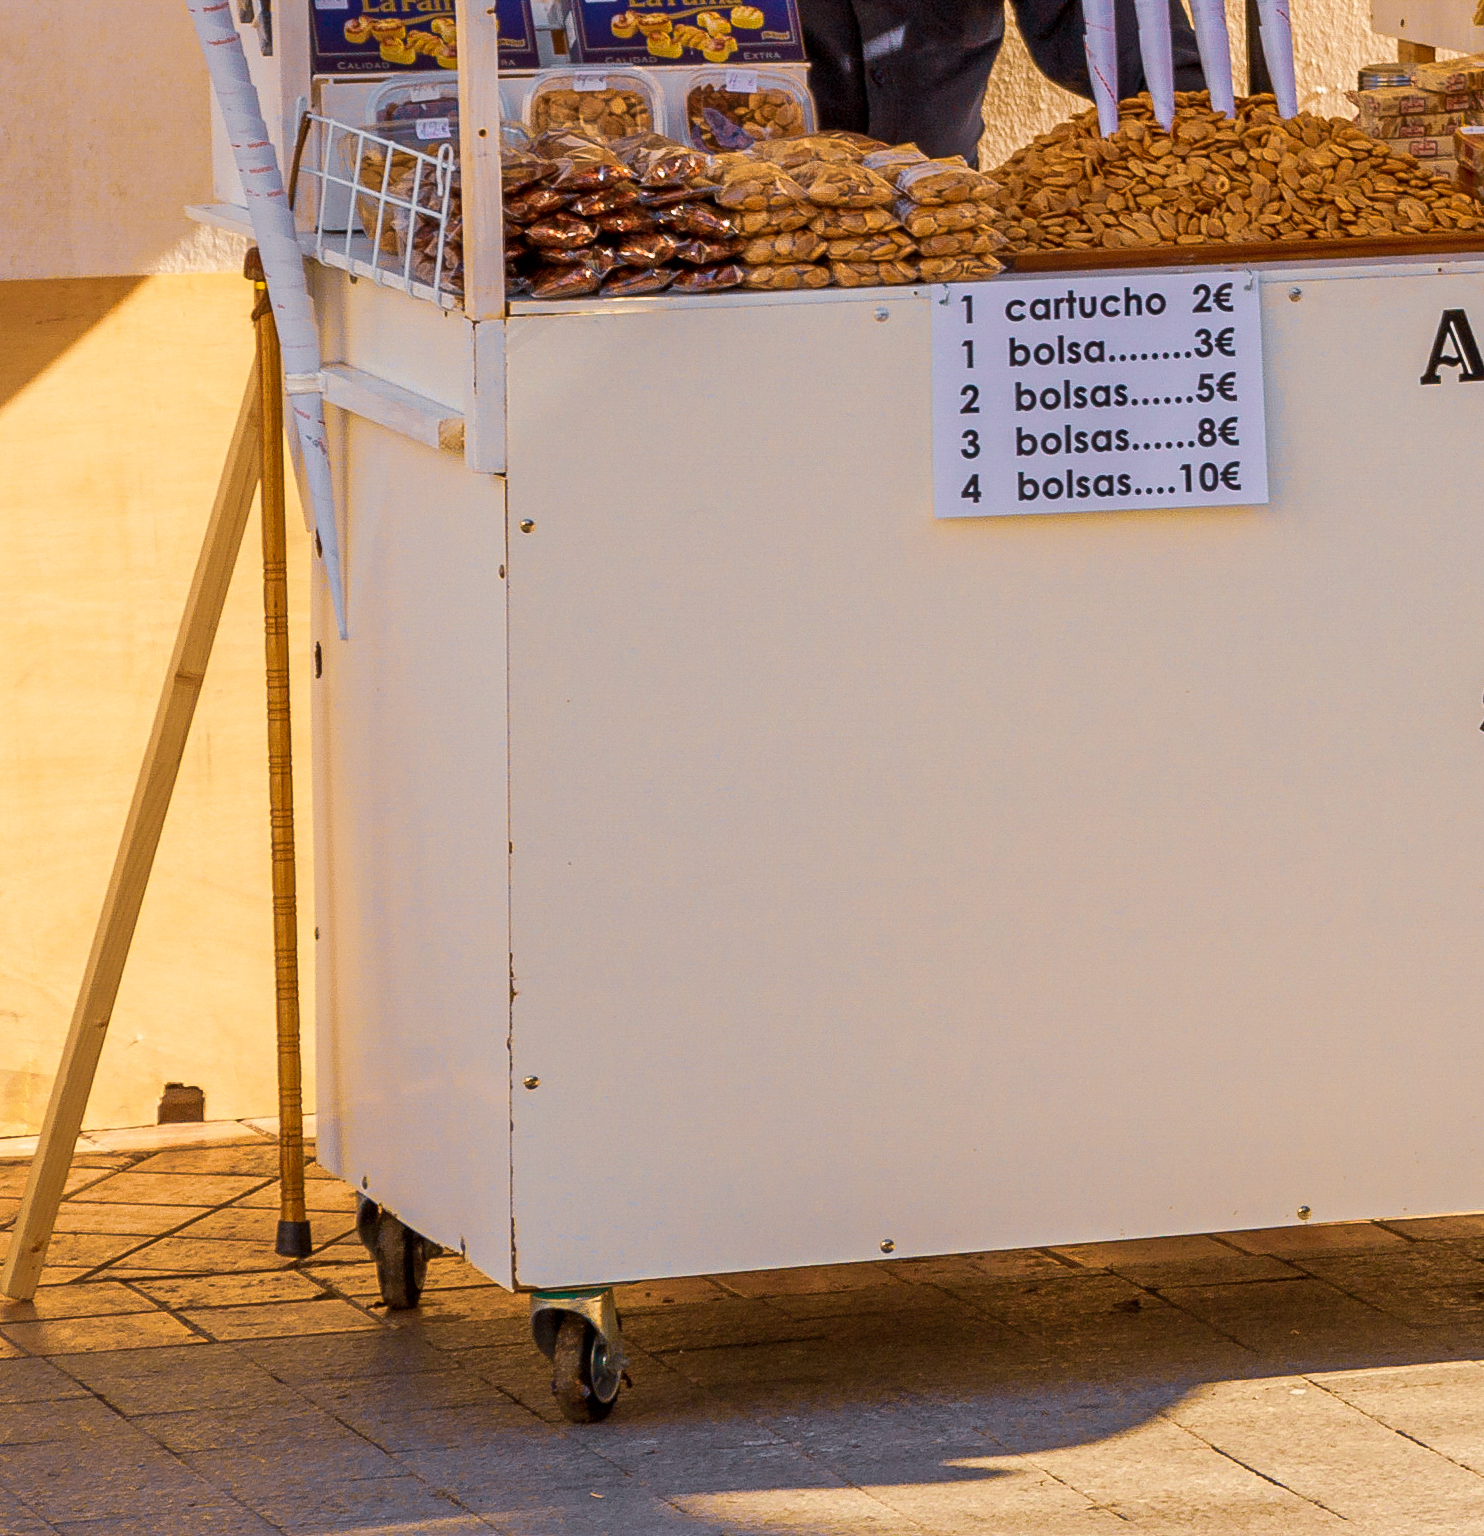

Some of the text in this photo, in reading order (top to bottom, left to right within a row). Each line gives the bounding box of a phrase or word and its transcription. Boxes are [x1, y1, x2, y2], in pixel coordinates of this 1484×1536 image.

[337, 61, 390, 70] CALIDAD
[743, 52, 782, 61] EXTRA
[961, 282, 1234, 324] 1 cartucho 2€
[961, 340, 974, 369] 1
[960, 385, 980, 414] 2
[961, 429, 981, 460] 3
[961, 473, 982, 503] 4
